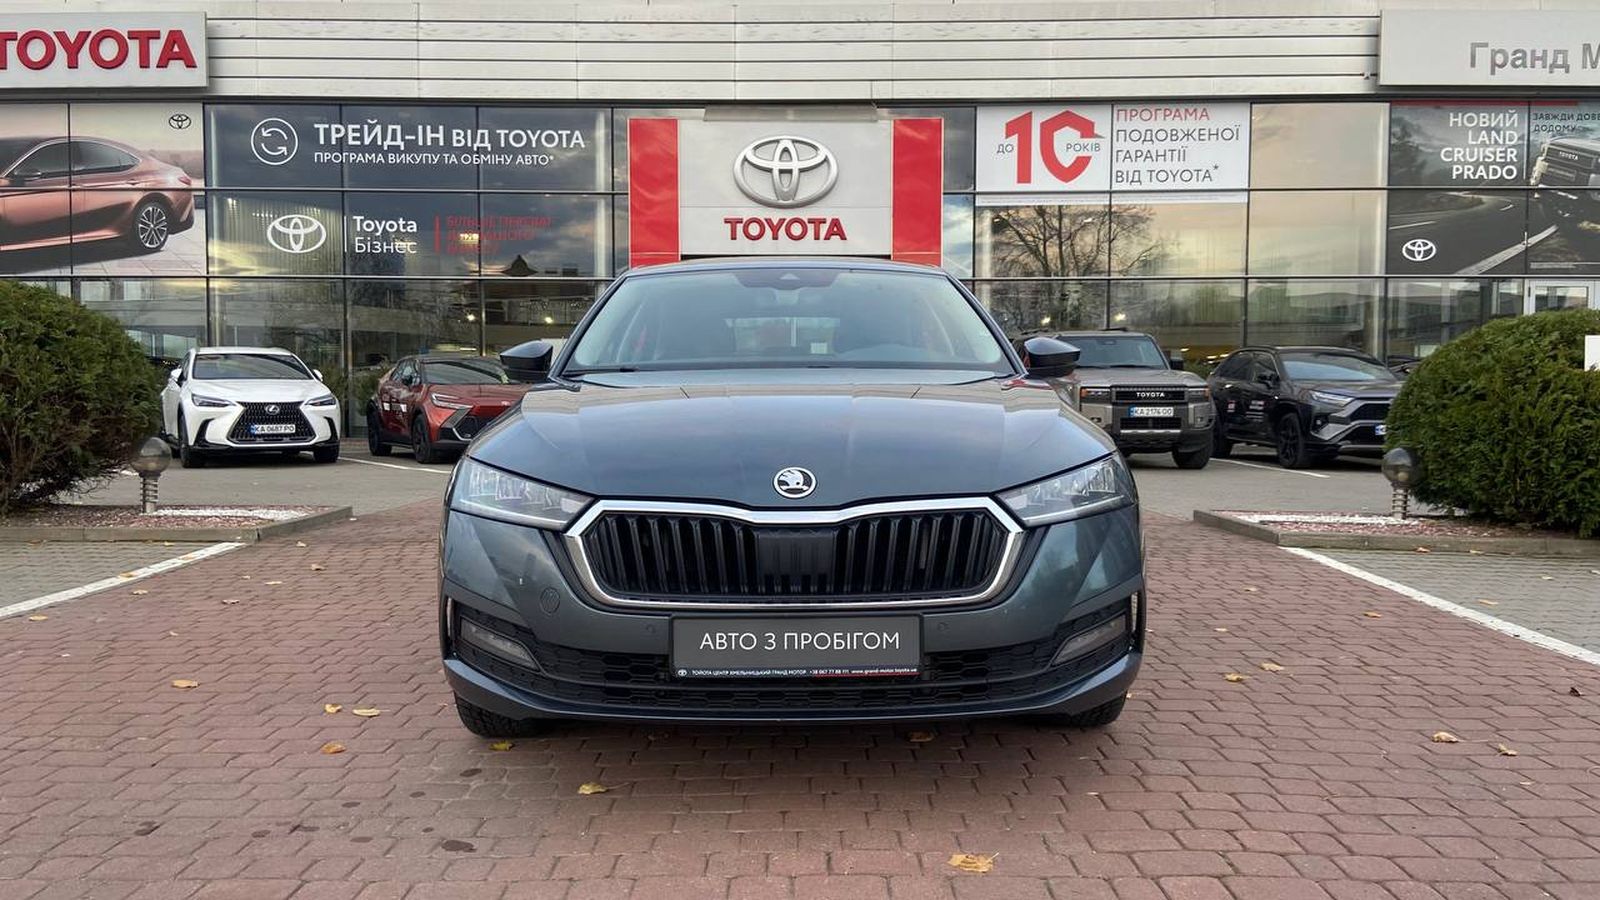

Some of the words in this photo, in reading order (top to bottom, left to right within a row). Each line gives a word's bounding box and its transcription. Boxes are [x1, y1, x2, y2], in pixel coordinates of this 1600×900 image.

[1469, 42, 1570, 75] Гранд
[1116, 108, 1210, 123] ПРОГРАМА
[1449, 110, 1518, 128] НОВИЙ
[1532, 113, 1574, 122] ЗАВЖДИ
[314, 119, 445, 150] ТРЕЙД-ІН
[452, 127, 491, 151] ВІД
[497, 130, 585, 149] TOYOTA
[1116, 124, 1241, 145] ПОДОВЖЕНОЇ
[1468, 131, 1518, 145] LAND
[997, 144, 1014, 154] ДО
[1066, 143, 1101, 153] РОКІВ
[1115, 145, 1188, 163] ГАРАНТІЇ
[1440, 147, 1518, 162] CRUISER
[314, 153, 385, 164] ПРОГРАМА
[388, 153, 440, 165] ВИКУПУ
[443, 154, 458, 164] ТА
[460, 154, 512, 165] ОБМІНУ
[1115, 170, 1142, 185] ВІД
[1452, 165, 1518, 180] PRADO
[353, 216, 417, 236] Toyota
[724, 217, 847, 240] TOYOTA
[354, 236, 417, 254] Бізнес
[700, 632, 757, 650] АВТО
[764, 632, 777, 650] З
[784, 632, 899, 650] ПРОБІГОМ
